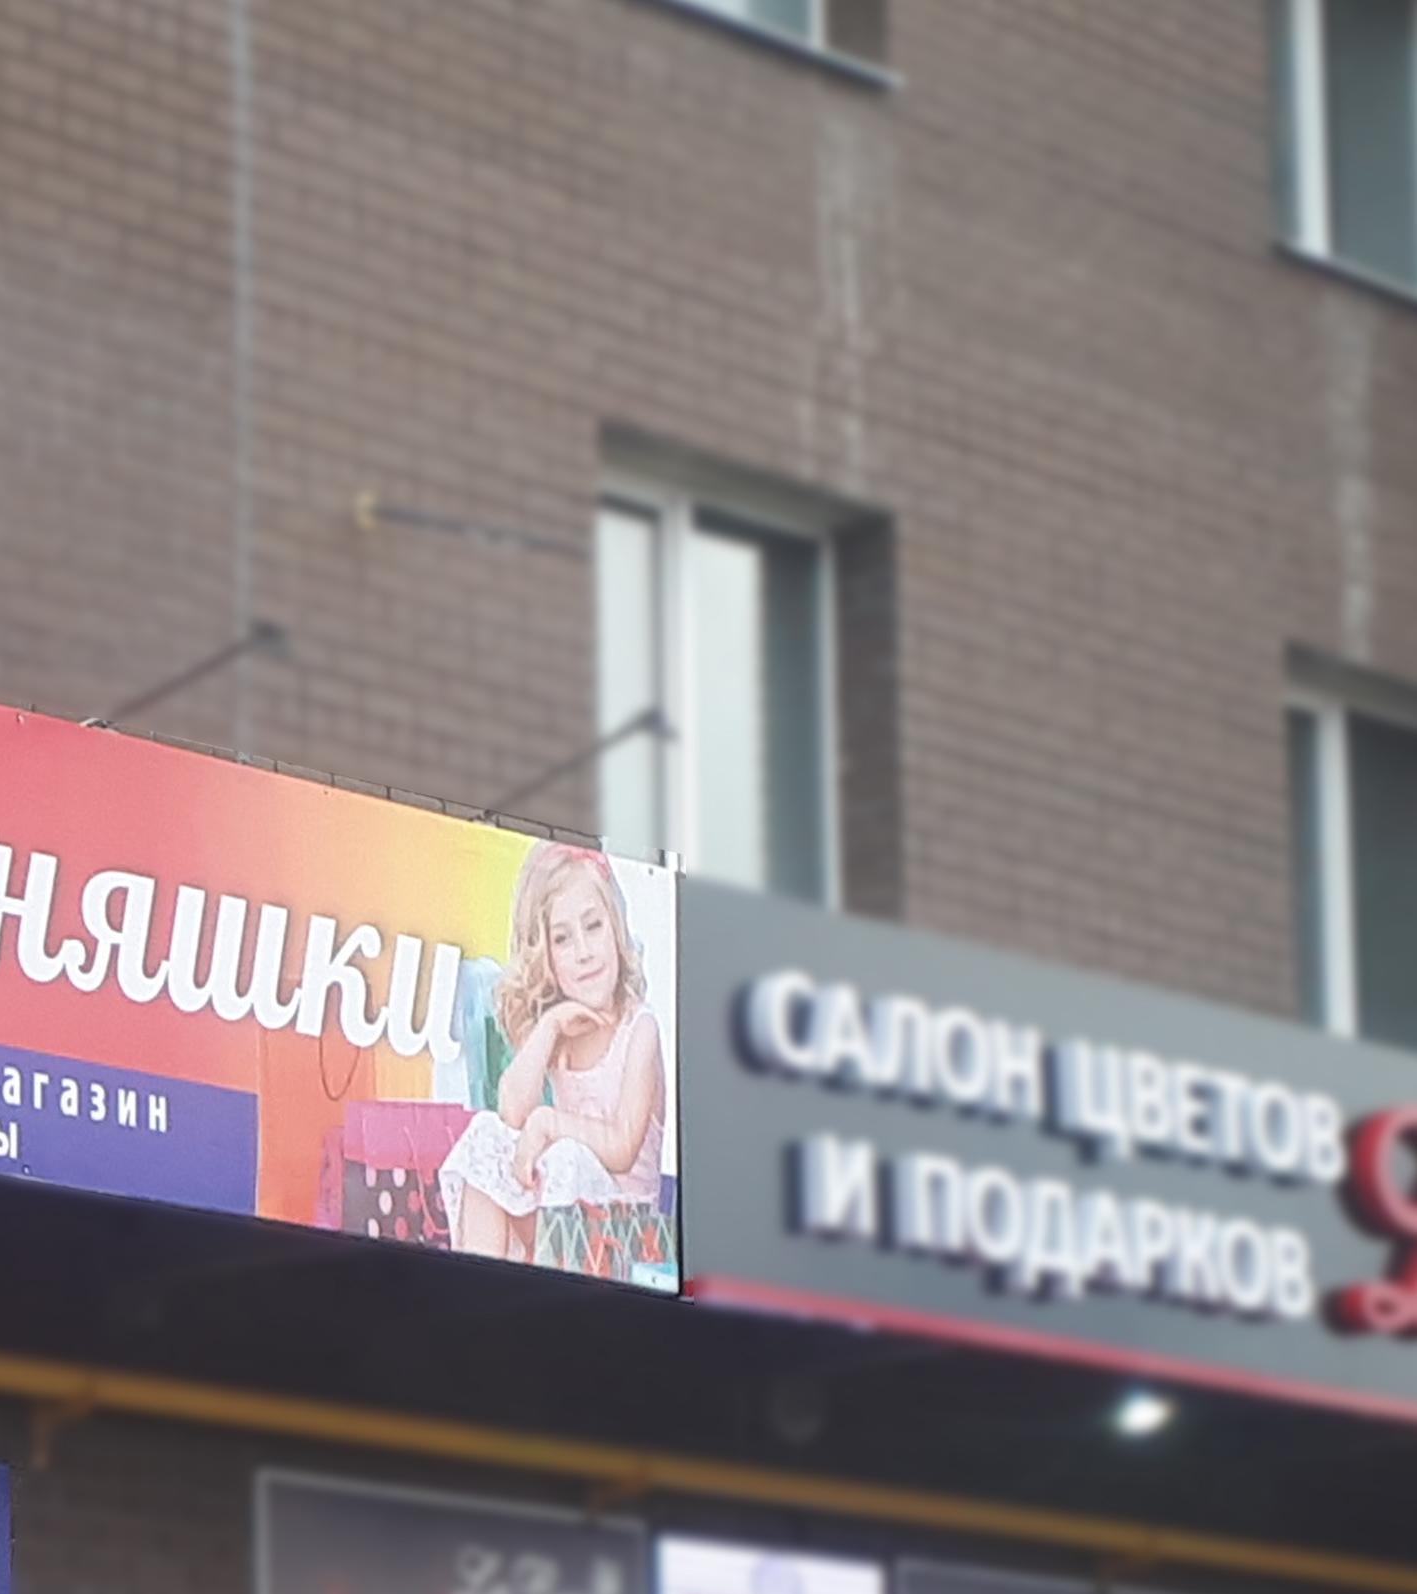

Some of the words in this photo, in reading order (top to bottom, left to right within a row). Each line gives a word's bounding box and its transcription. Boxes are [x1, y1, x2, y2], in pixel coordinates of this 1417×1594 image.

[740, 969, 1043, 1118] САЛОН
[1059, 1037, 1346, 1184] ЦВЕТОВ
[799, 1132, 876, 1238] И
[901, 1153, 1315, 1318] ПОДАРКОВ
